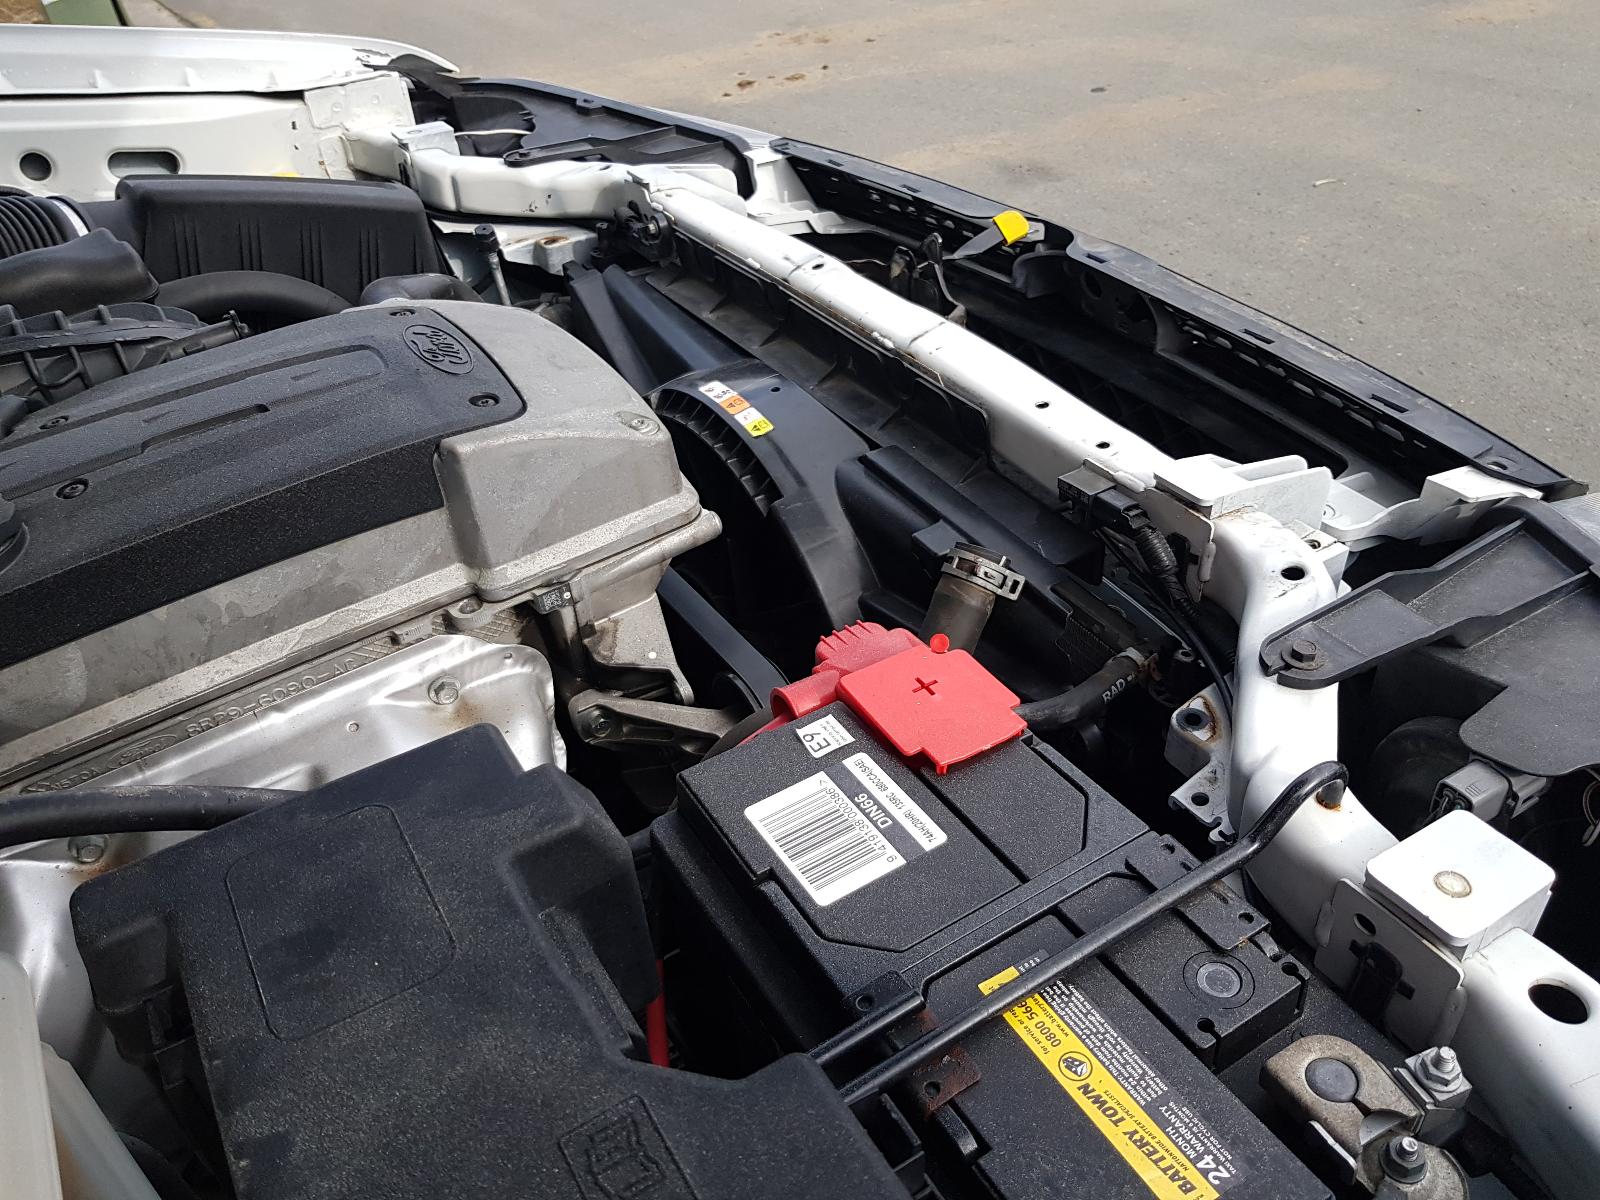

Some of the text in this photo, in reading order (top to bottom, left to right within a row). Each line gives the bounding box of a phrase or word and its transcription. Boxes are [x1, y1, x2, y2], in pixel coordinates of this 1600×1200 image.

[1101, 678, 1127, 704] RAD
[804, 731, 831, 753] E9
[854, 793, 893, 829] DIN66
[854, 819, 887, 851] 419138
[886, 854, 898, 863] 9
[1023, 1024, 1042, 1045] service
[1034, 1020, 1062, 1048] 0800
[1040, 1045, 1050, 1055] for
[1117, 1074, 1146, 1106] WARRANTY:
[1076, 1082, 1198, 1195] BATTERY TOWN
[1103, 1089, 1190, 1171] NATIONWIDE BATTERY SPECIALISTS
[1158, 1105, 1205, 1154] WARRANTY
[1165, 1126, 1198, 1159] MONTH
[1209, 1135, 1222, 1148] FOR
[1196, 1132, 1226, 1162] WARRANTY
[1195, 1154, 1231, 1185] 24
